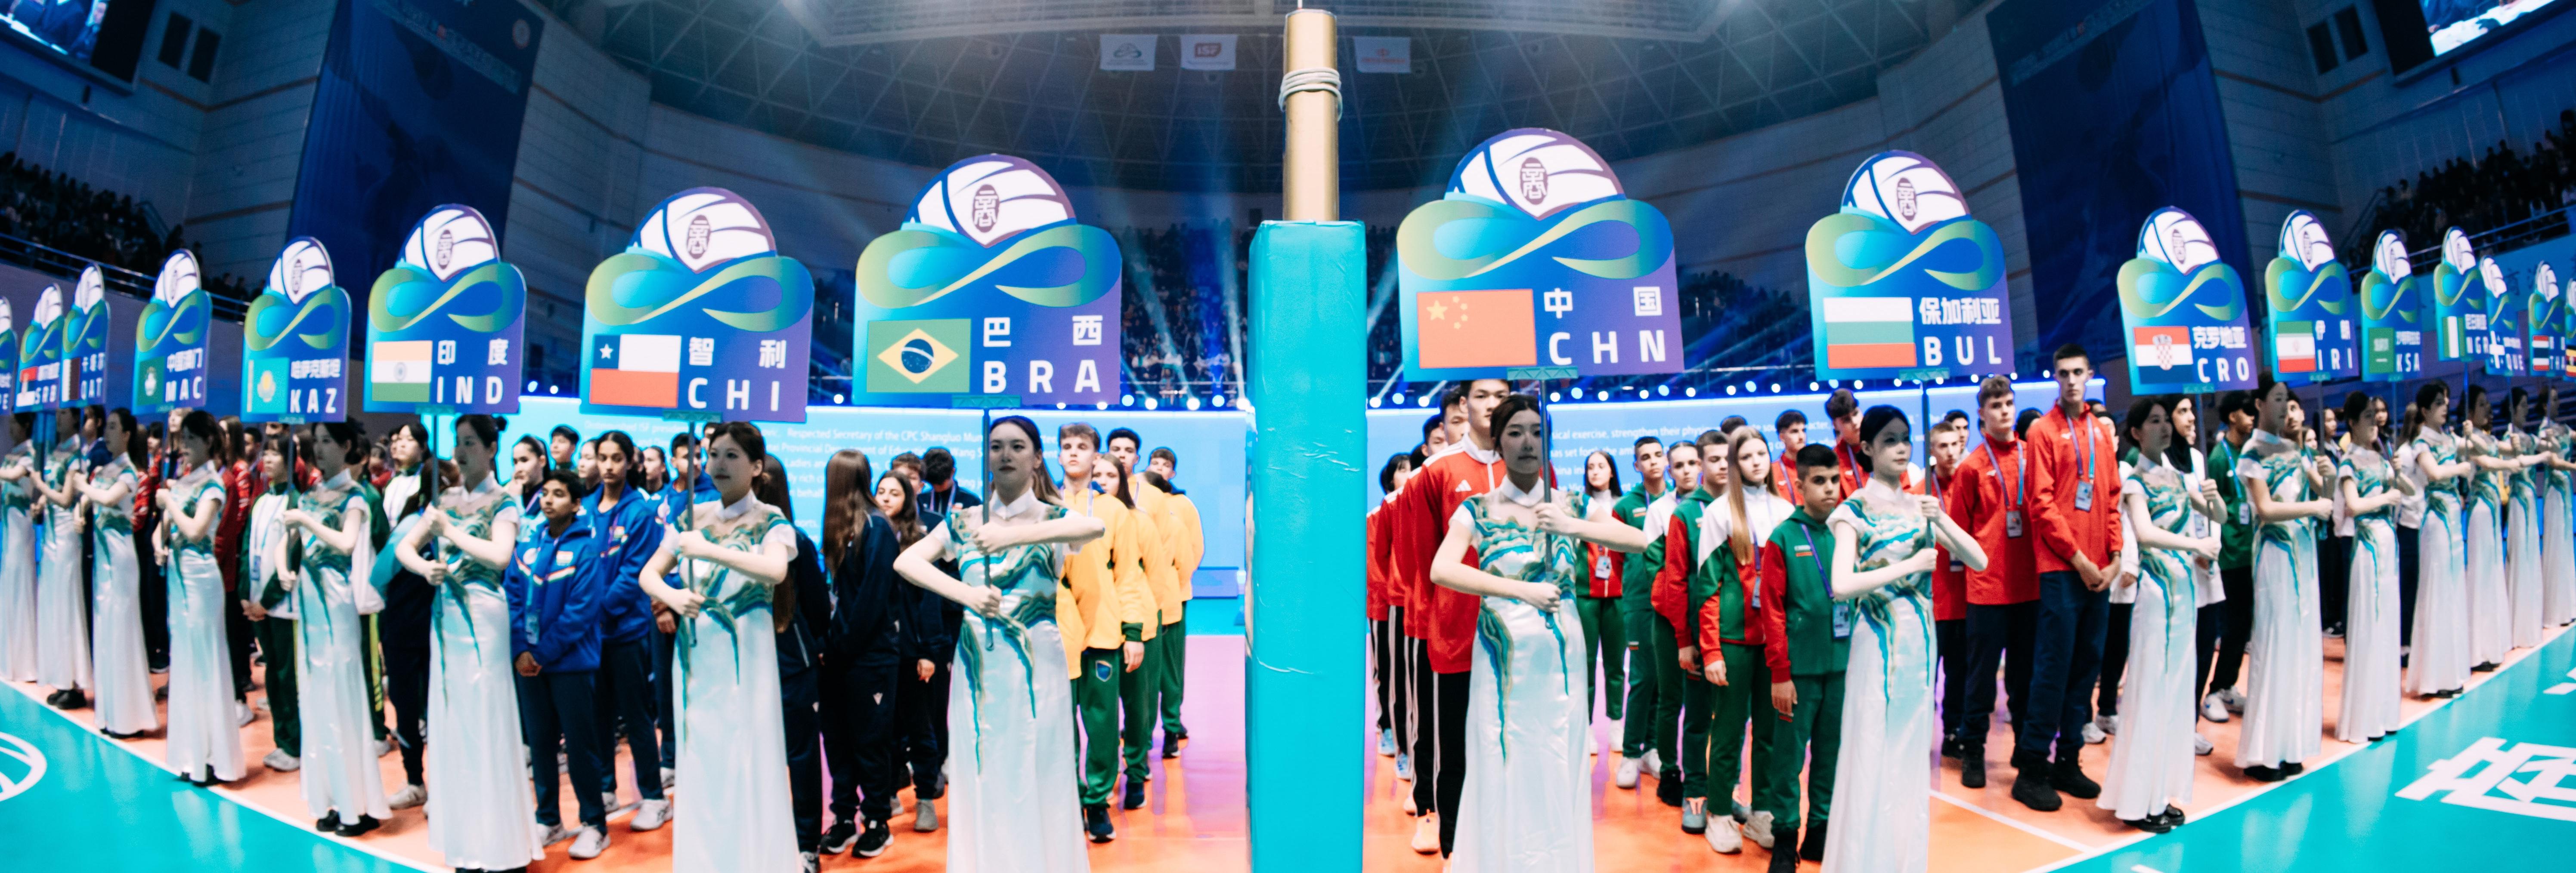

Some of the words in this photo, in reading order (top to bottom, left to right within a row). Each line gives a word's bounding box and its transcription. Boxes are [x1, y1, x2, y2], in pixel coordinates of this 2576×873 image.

[1544, 286, 1663, 319] 中国
[1919, 297, 2002, 325] 保加利亚
[983, 315, 1103, 348] 巴西
[2192, 326, 2248, 349] 克罗地亚
[437, 338, 509, 366] 印度
[689, 336, 787, 369] 智利
[1548, 330, 1666, 366] CHN
[1923, 336, 2002, 366] BUL
[2317, 348, 2353, 370] IRI
[2197, 357, 2249, 383] CRO
[2396, 352, 2420, 372] KSA
[80, 377, 103, 400] QAT
[165, 376, 202, 402] MAC
[437, 375, 504, 404] IND
[983, 359, 1101, 394] BRA
[35, 383, 57, 404] SRB
[290, 388, 337, 413] KAZ
[687, 377, 780, 411] CHI
[787, 428, 830, 440] Respected
[833, 429, 872, 443] Secretary
[874, 429, 884, 440] of
[885, 431, 899, 441] the
[901, 432, 918, 441] CPC
[920, 432, 961, 444] Shangluo
[1660, 426, 1680, 436] their
